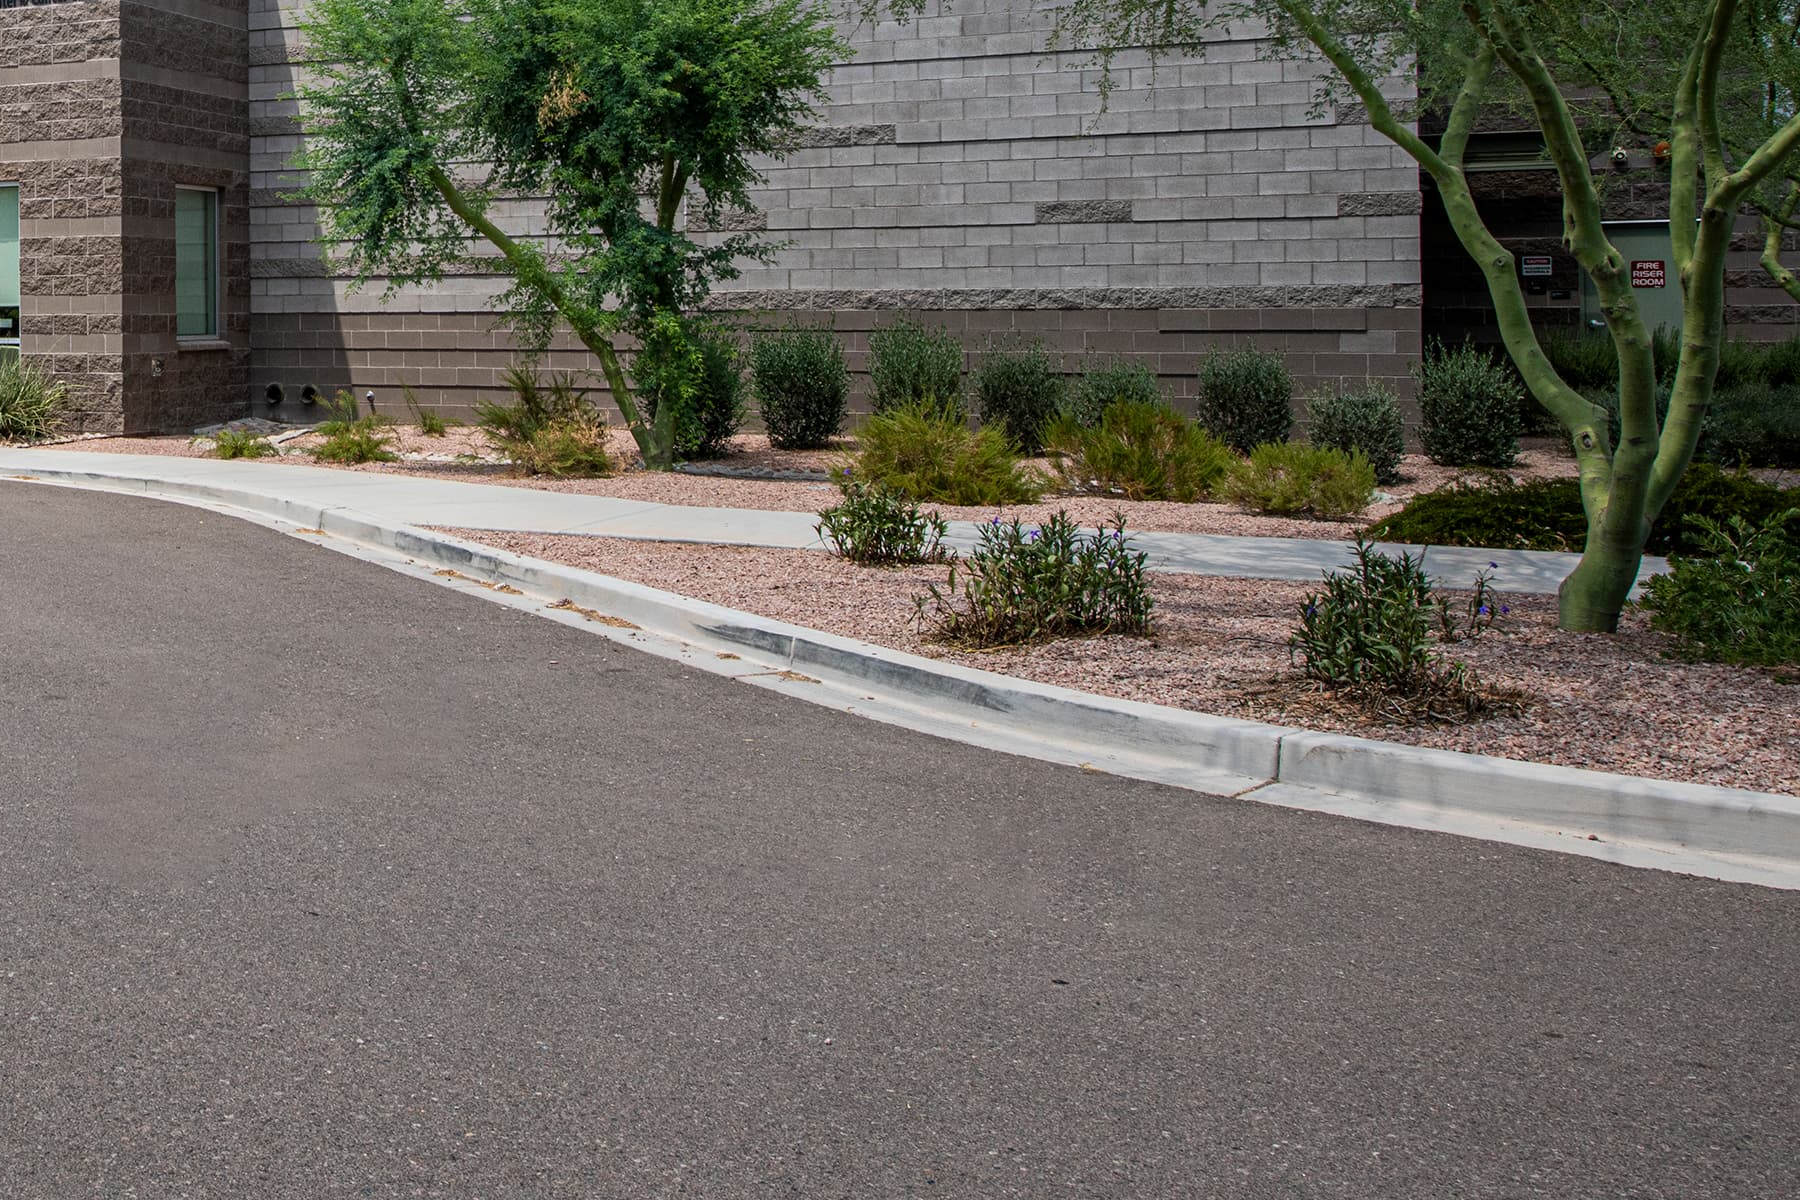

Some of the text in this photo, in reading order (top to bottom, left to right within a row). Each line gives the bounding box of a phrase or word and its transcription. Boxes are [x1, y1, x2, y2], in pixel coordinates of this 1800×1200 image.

[1636, 262, 1660, 270] FIRE
[1632, 270, 1664, 278] RISER
[1632, 278, 1664, 286] ROOM
